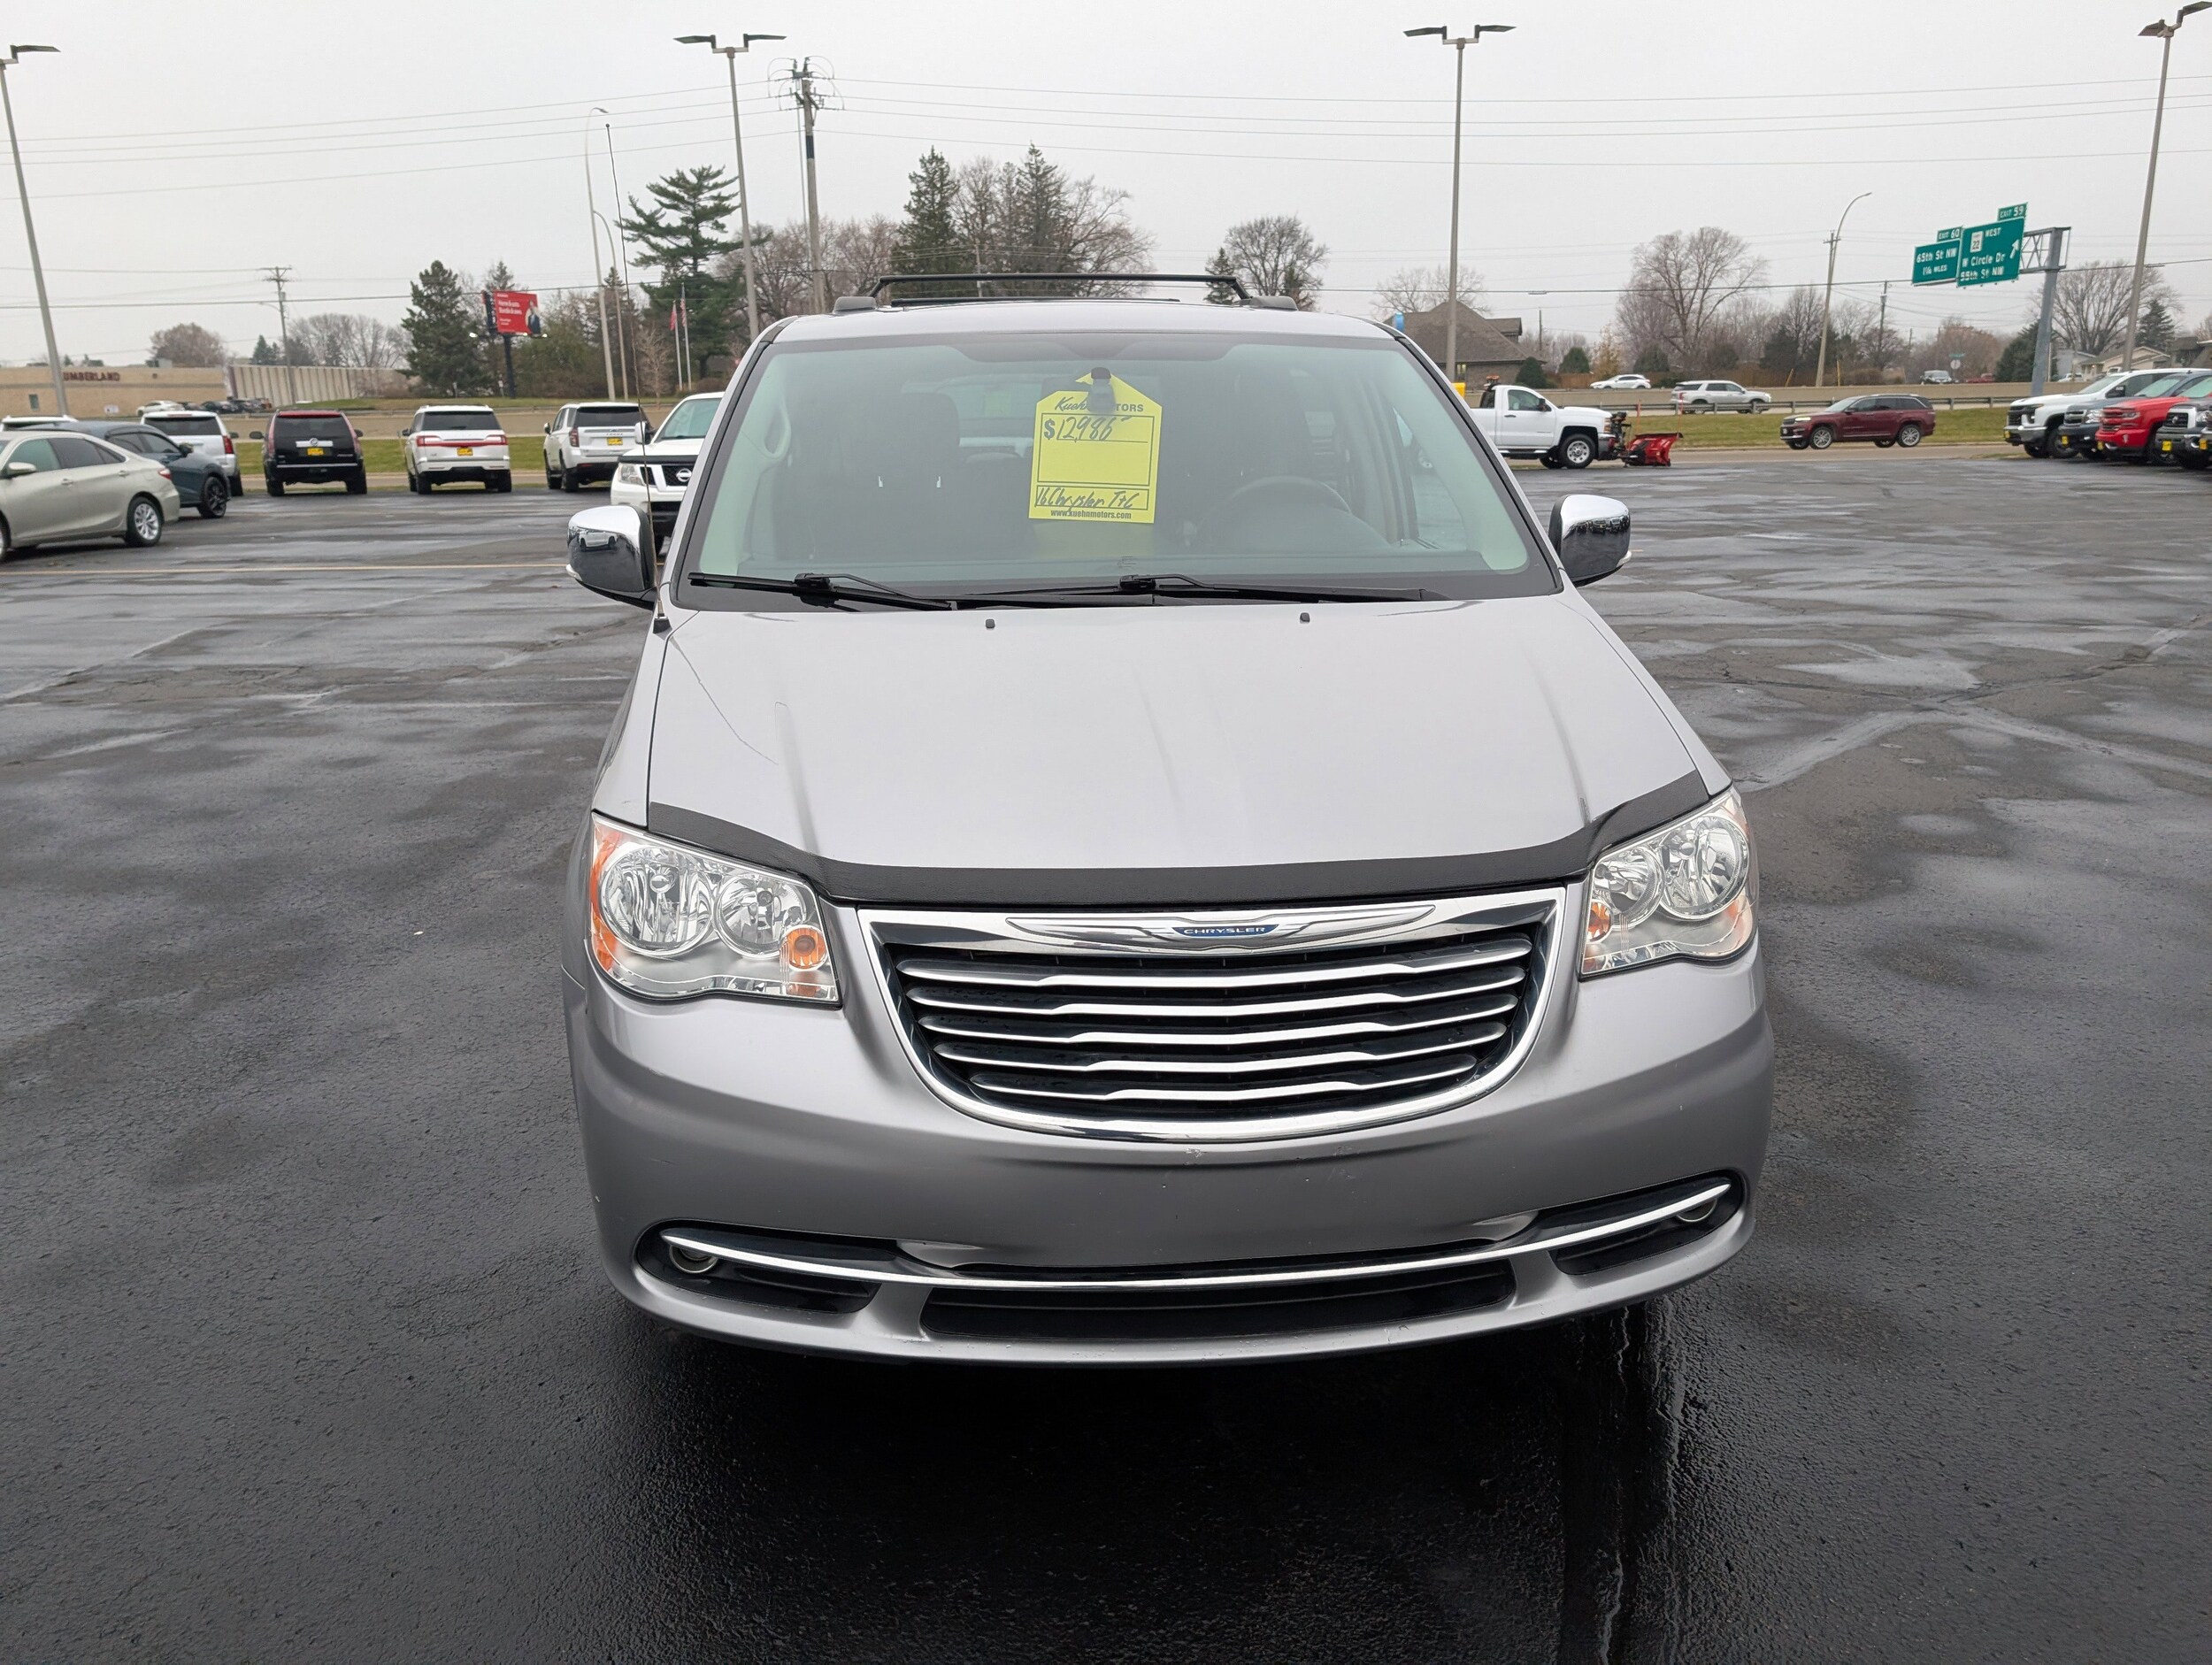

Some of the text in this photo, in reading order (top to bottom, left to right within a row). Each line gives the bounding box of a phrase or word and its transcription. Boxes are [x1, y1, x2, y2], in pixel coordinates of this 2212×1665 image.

[2013, 206, 2024, 216] 59
[1951, 229, 1960, 238] 60
[1985, 227, 2001, 237] WEST
[1916, 247, 1957, 263] 65th St NW
[1971, 254, 1993, 266] Circle
[1996, 252, 2005, 262] Dr
[1981, 269, 1989, 278] St
[1992, 266, 2004, 276] NW
[1050, 509, 1132, 519] www.kuehnmotors.com
